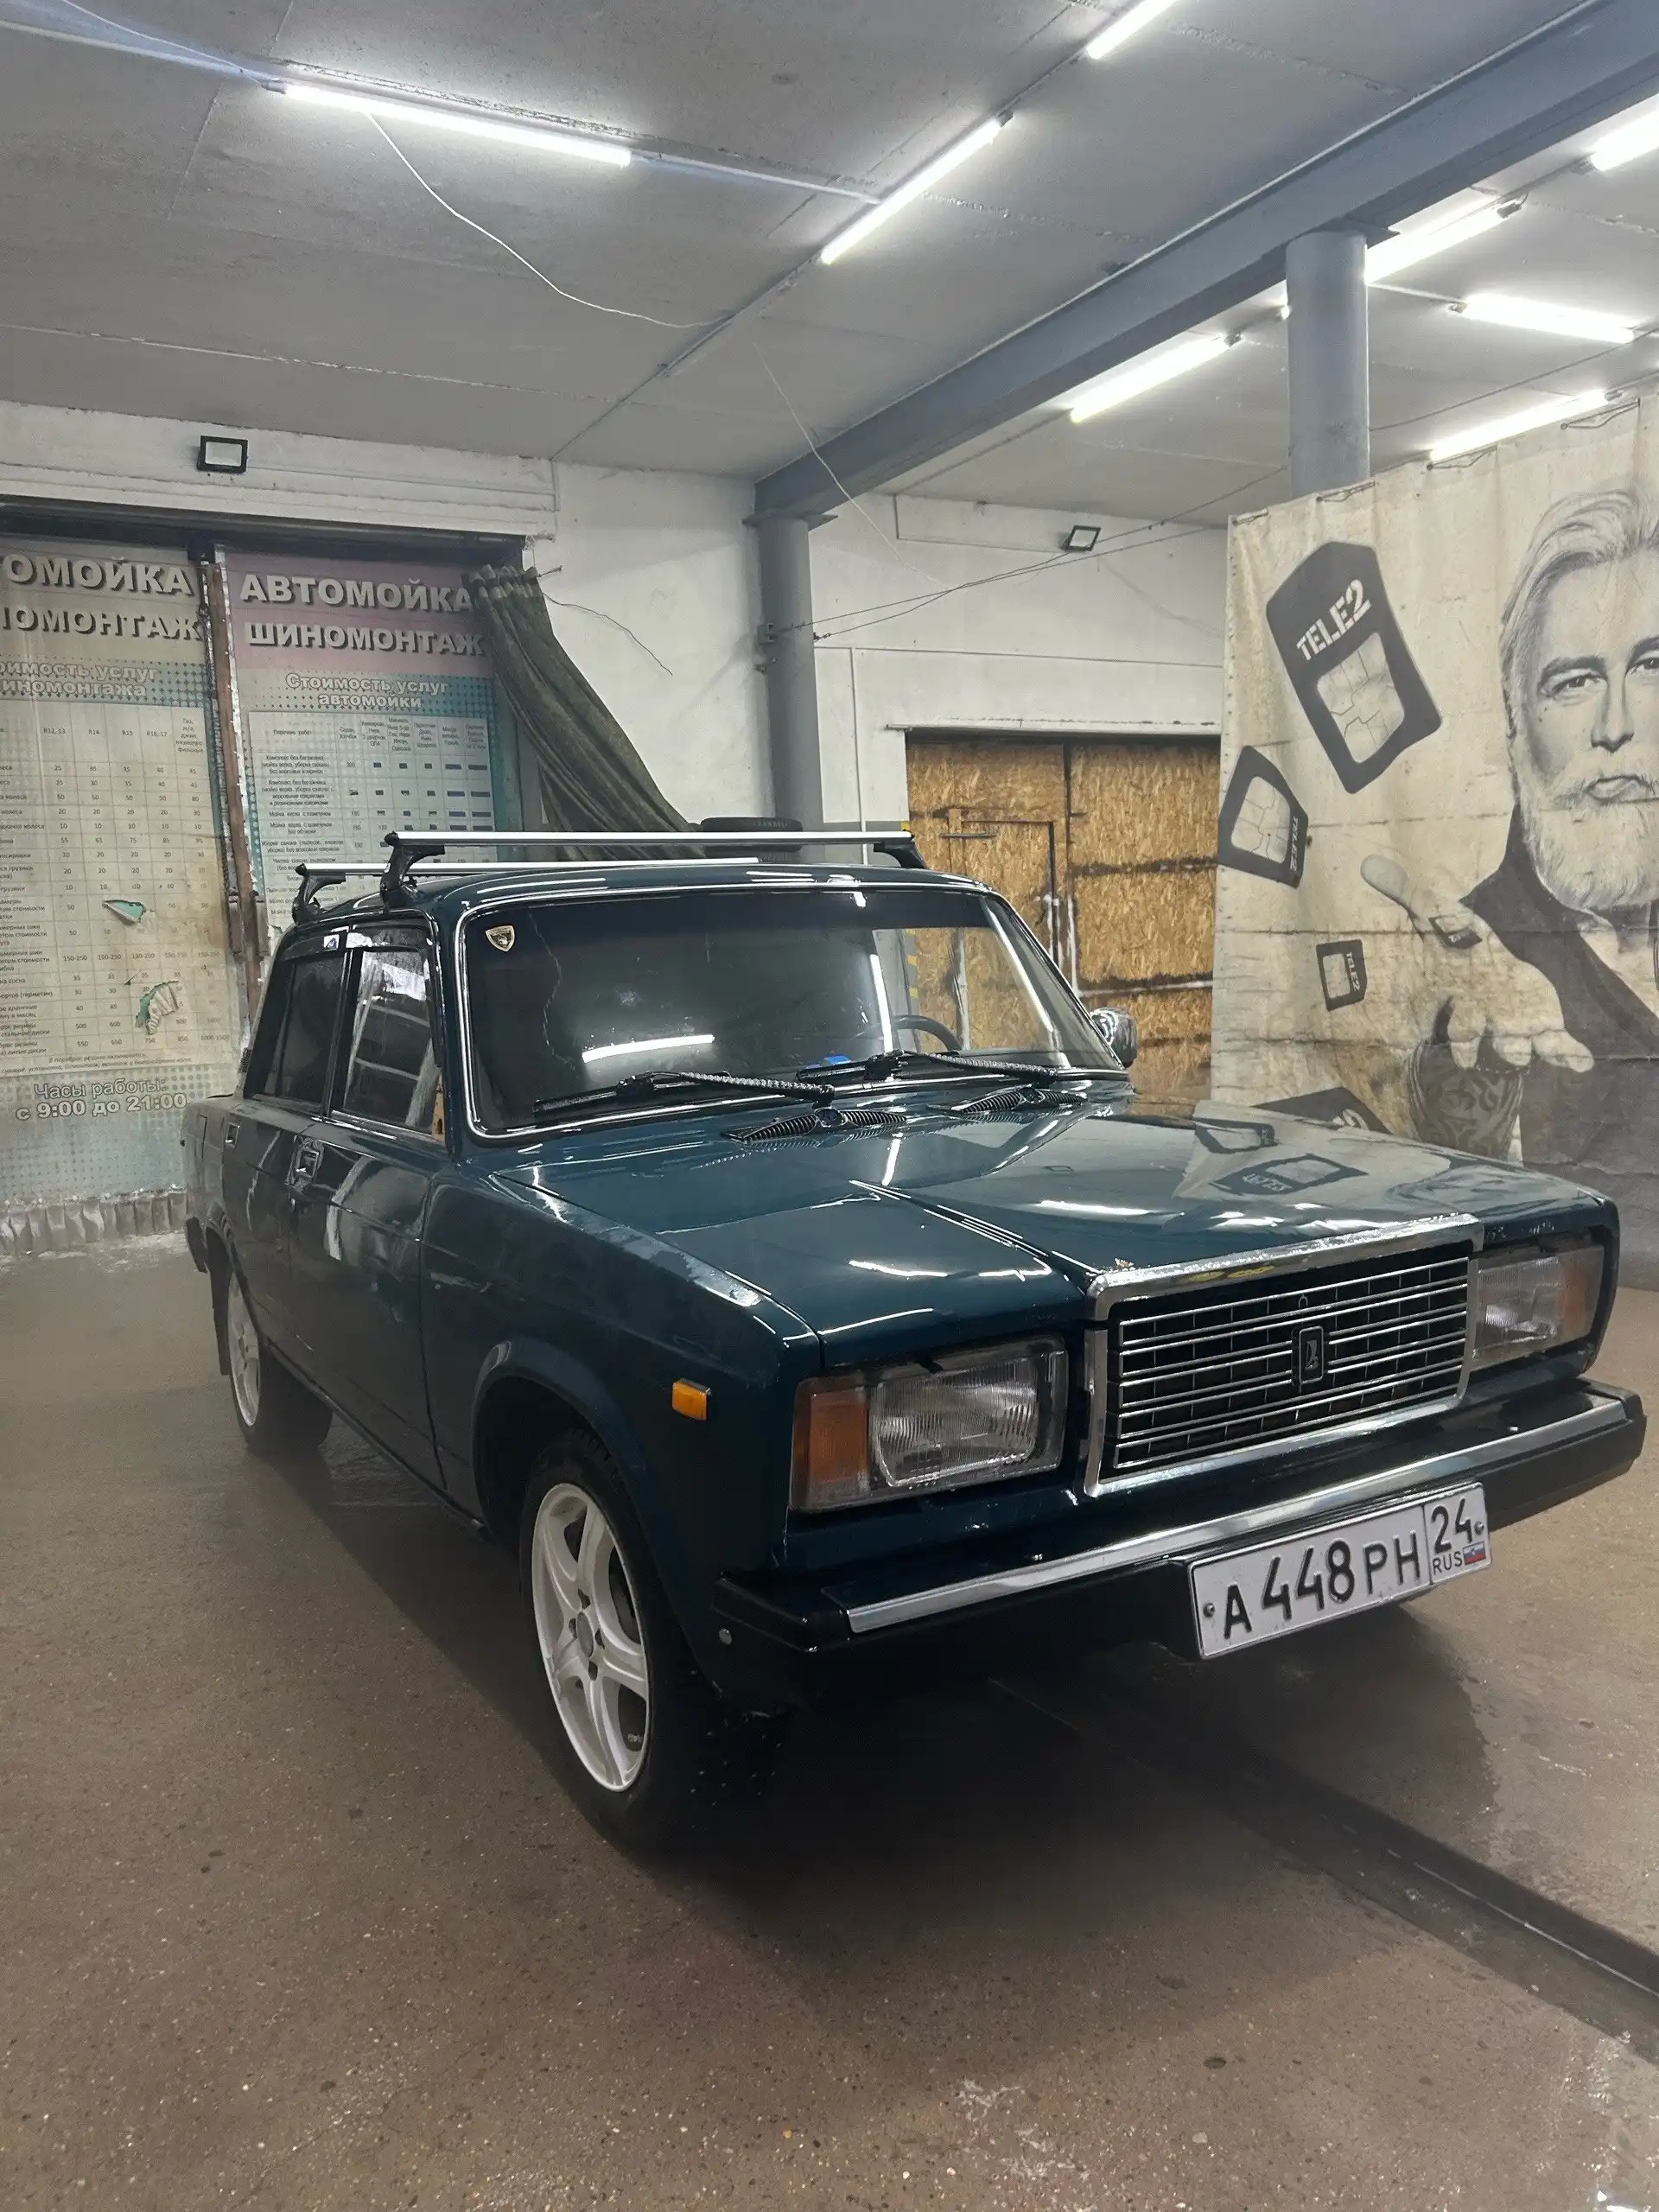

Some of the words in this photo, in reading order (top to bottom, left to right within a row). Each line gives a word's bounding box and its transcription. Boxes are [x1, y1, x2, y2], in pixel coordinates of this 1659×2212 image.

[239, 574, 474, 612] АВТОМОЙКА
[1296, 579, 1371, 661] TELE2
[245, 622, 485, 655] ШИНОМОНТАЖ
[94, 664, 160, 682] услуг
[284, 672, 391, 692] Стоимость
[396, 679, 449, 696] услуг
[317, 690, 422, 709] автомойки
[1346, 951, 1361, 992] TELE2
[34, 1084, 86, 1099] Часы
[92, 1077, 166, 1099] работы:
[16, 1108, 31, 1121] с
[37, 1100, 86, 1119] 9:00
[92, 1101, 120, 1117] до
[126, 1093, 188, 1112] 21:00
[1430, 1497, 1472, 1554] 24
[1433, 1553, 1463, 1575] RUS
